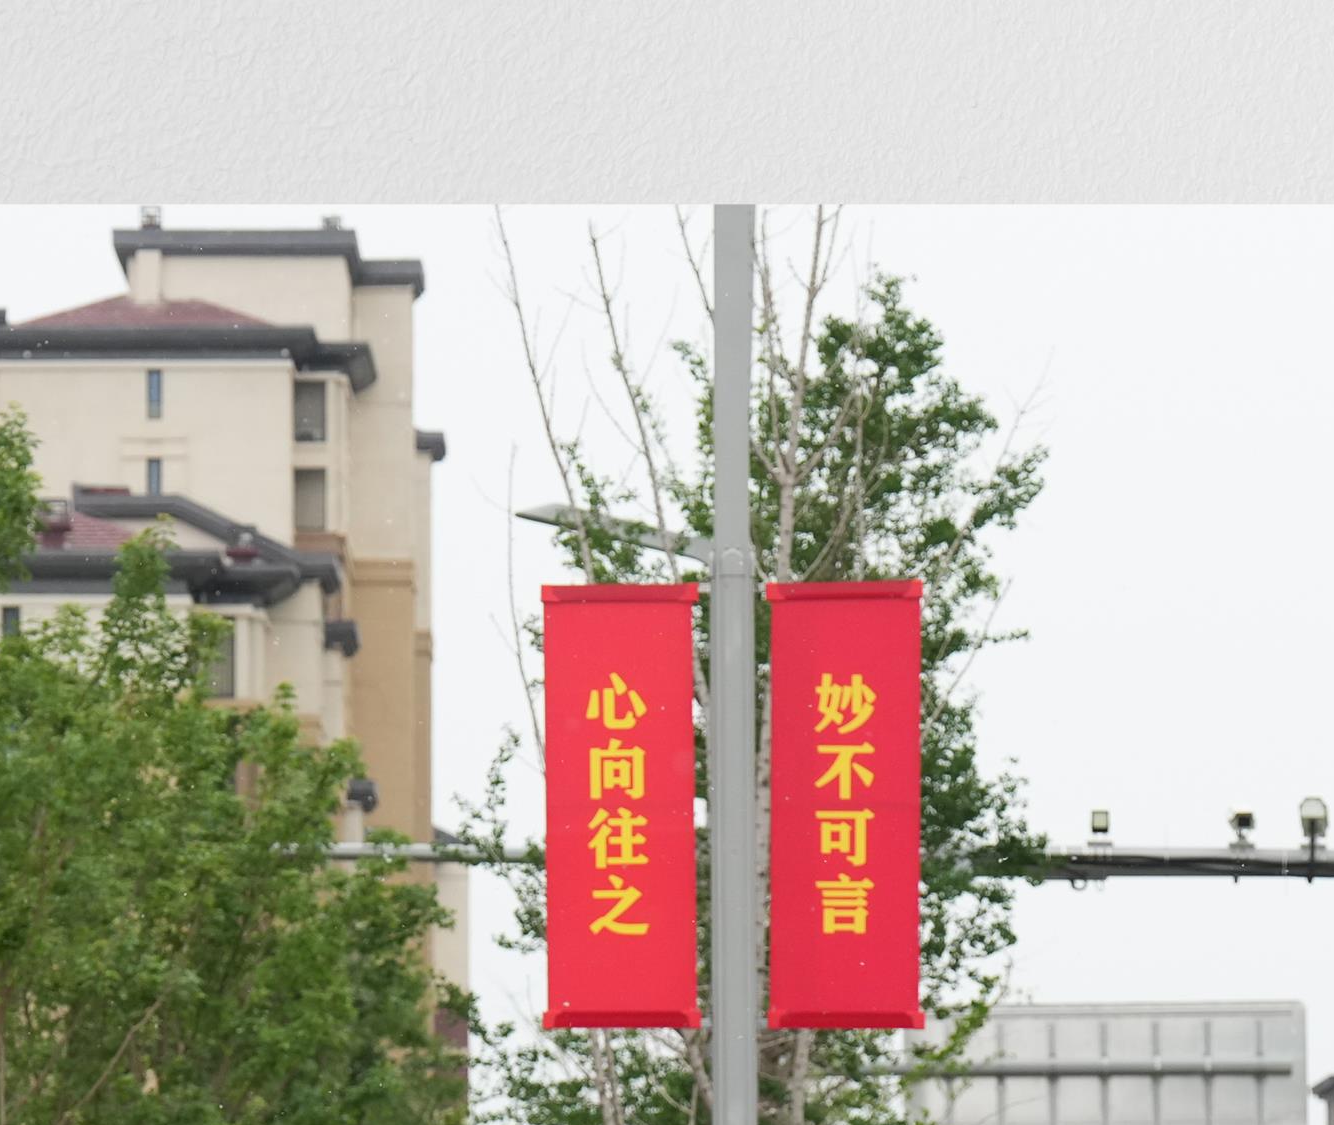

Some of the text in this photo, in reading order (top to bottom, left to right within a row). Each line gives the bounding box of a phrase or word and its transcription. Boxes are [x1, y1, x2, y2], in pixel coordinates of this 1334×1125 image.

[585, 671, 650, 937] 心向往之
[814, 672, 877, 936] 妙不可言
